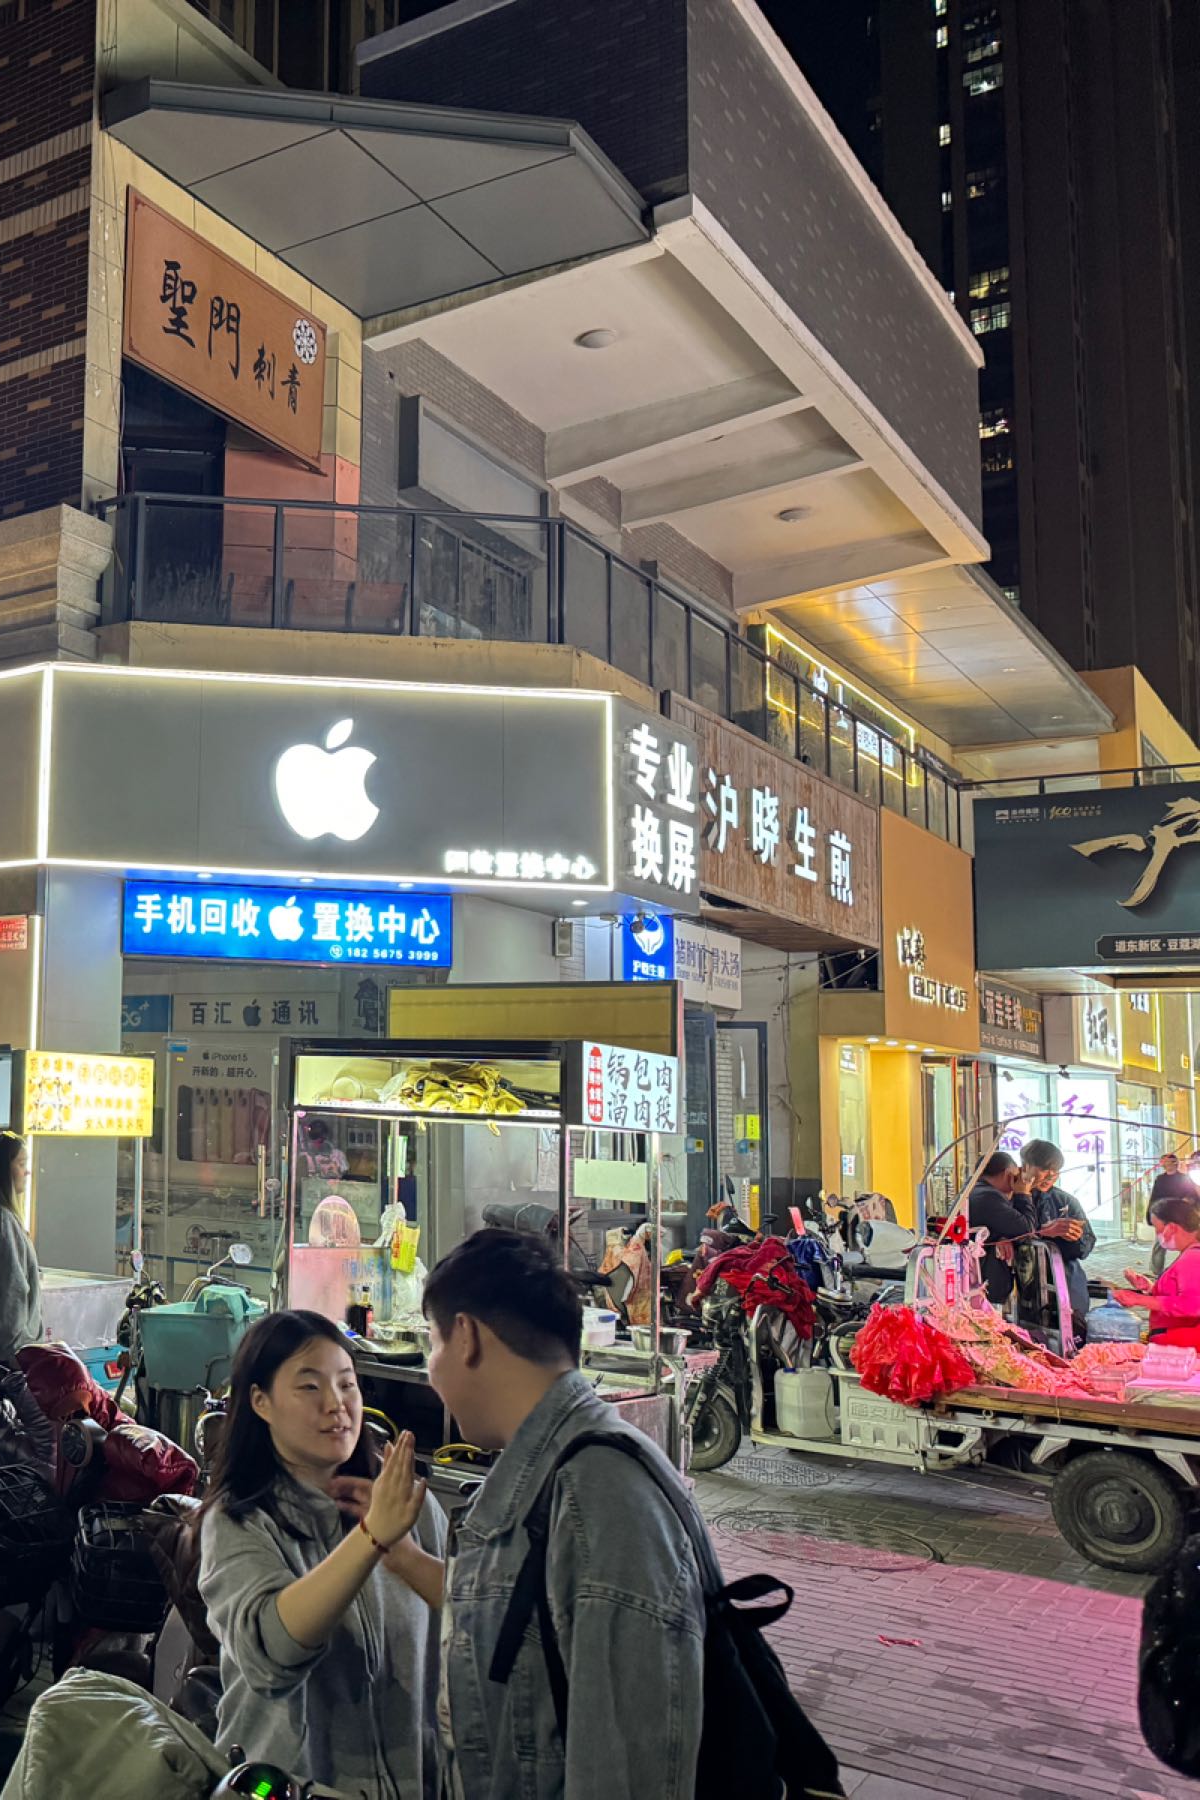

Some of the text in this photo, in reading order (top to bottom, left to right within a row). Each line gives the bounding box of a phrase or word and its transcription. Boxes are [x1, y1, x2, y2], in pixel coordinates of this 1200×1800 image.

[629, 722, 696, 814] 专业
[631, 803, 697, 895] 换屏
[704, 767, 853, 907] 沪晓生煎
[133, 893, 441, 945] 手机回收 置换中心
[189, 1000, 319, 1026] 百汇 通讯
